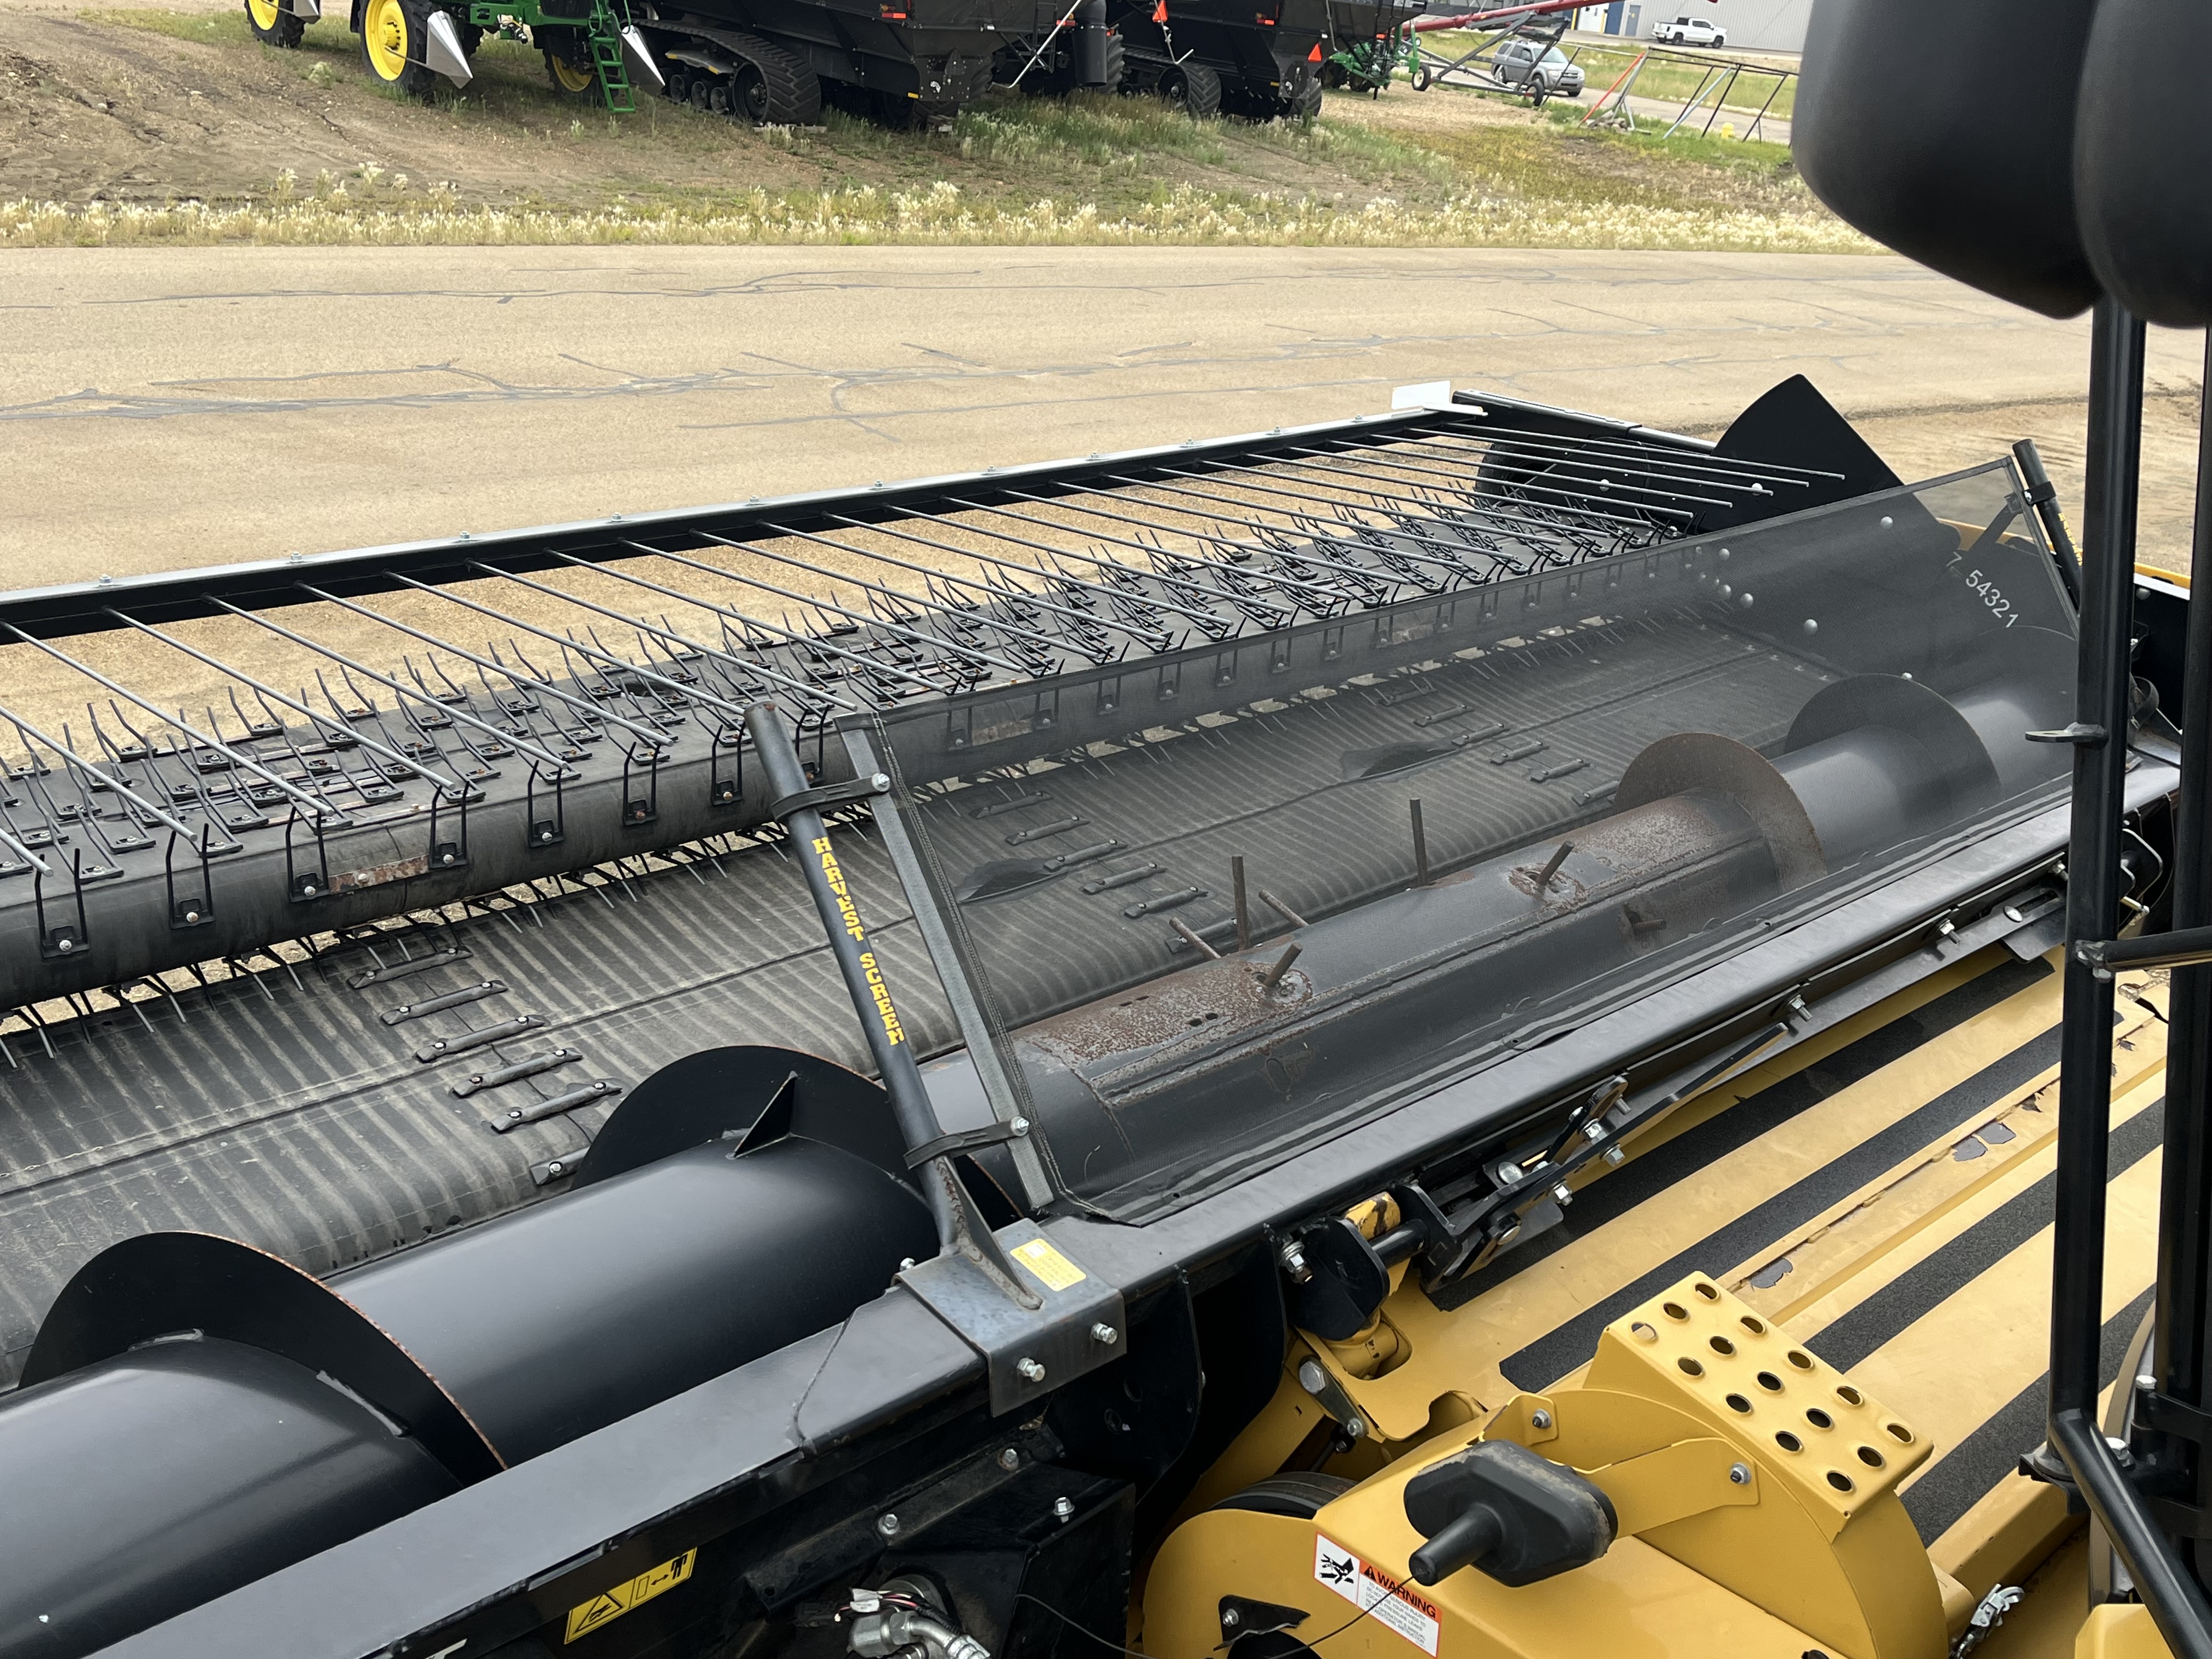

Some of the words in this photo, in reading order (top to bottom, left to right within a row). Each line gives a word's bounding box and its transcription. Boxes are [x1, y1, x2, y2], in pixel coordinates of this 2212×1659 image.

[1946, 551, 1962, 567] 7
[812, 837, 865, 941] HARVEST
[859, 952, 905, 1046] SCREEN
[1378, 1571, 1436, 1619] WARNING
